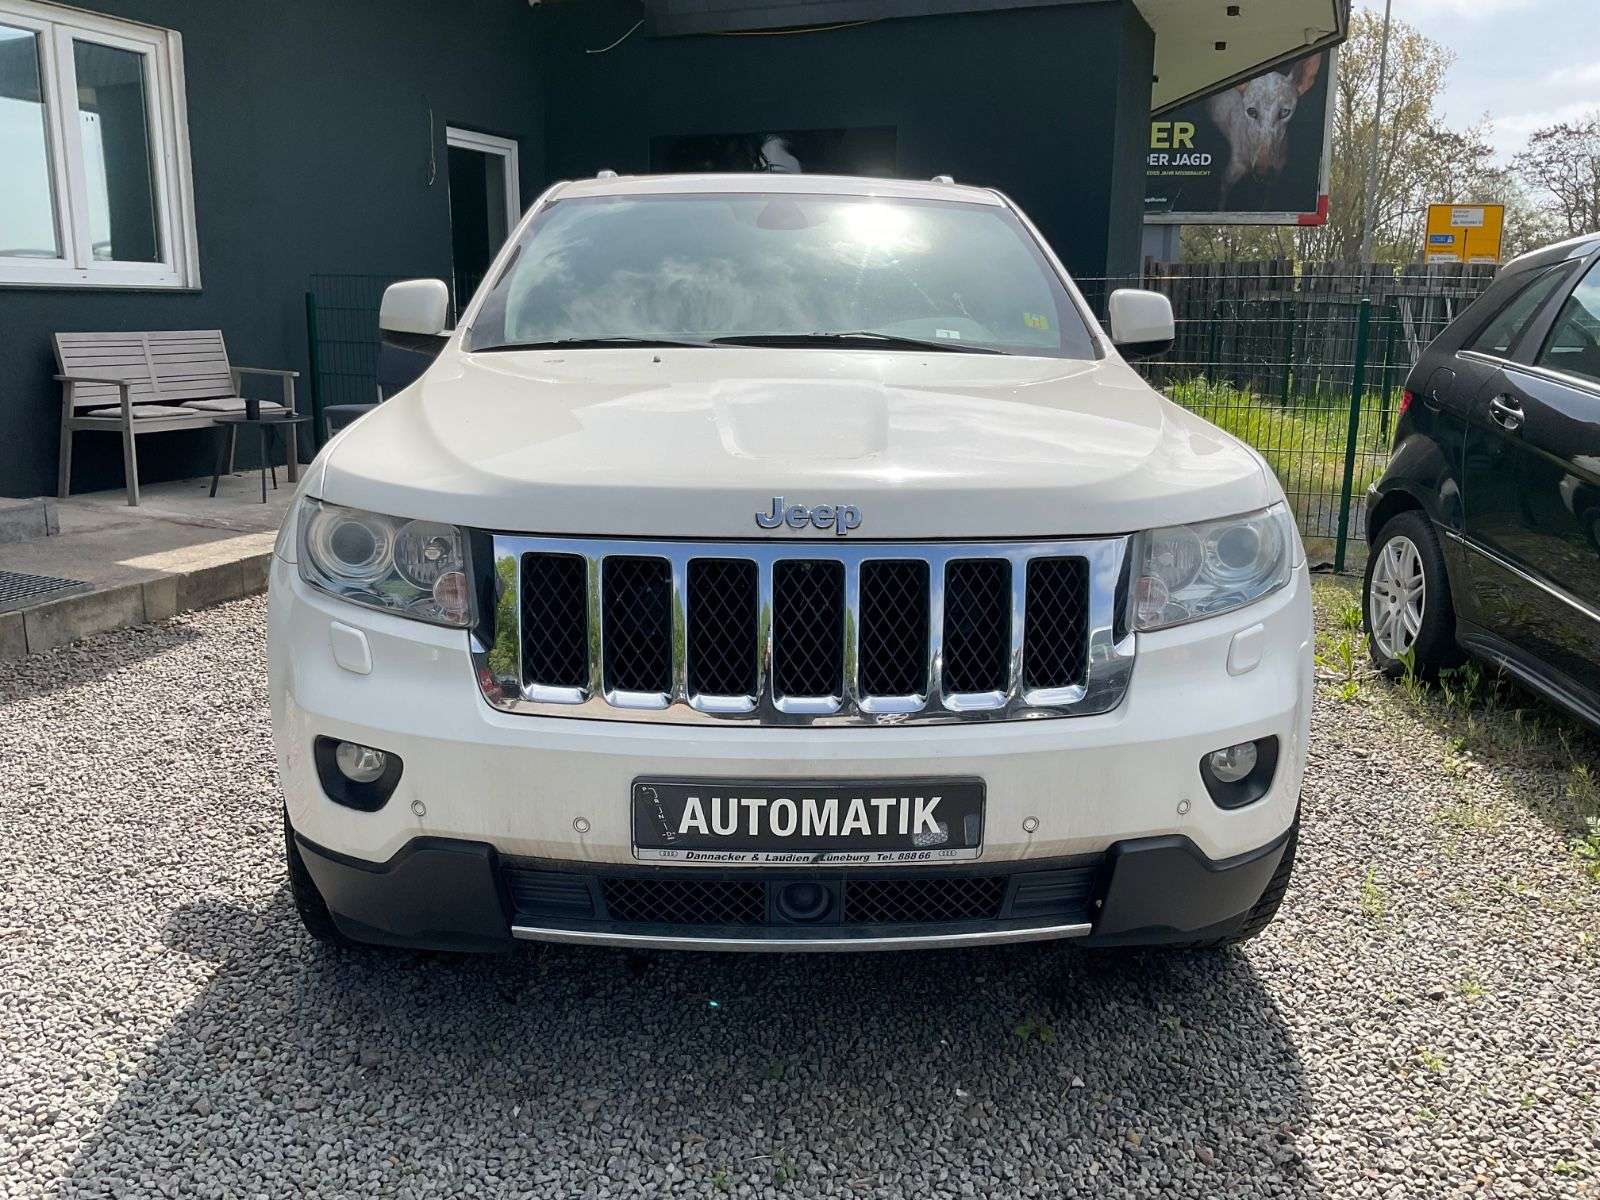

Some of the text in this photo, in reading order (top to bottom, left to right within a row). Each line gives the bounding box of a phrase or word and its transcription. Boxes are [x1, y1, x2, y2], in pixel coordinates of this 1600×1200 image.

[1146, 153, 1212, 166] ER JAGD
[755, 496, 862, 535] Jeep
[678, 796, 942, 837] AUTOMATIK
[685, 851, 746, 862] Dannacker
[751, 853, 760, 862] &
[764, 853, 810, 862] Laudien
[877, 853, 895, 861] Tel.
